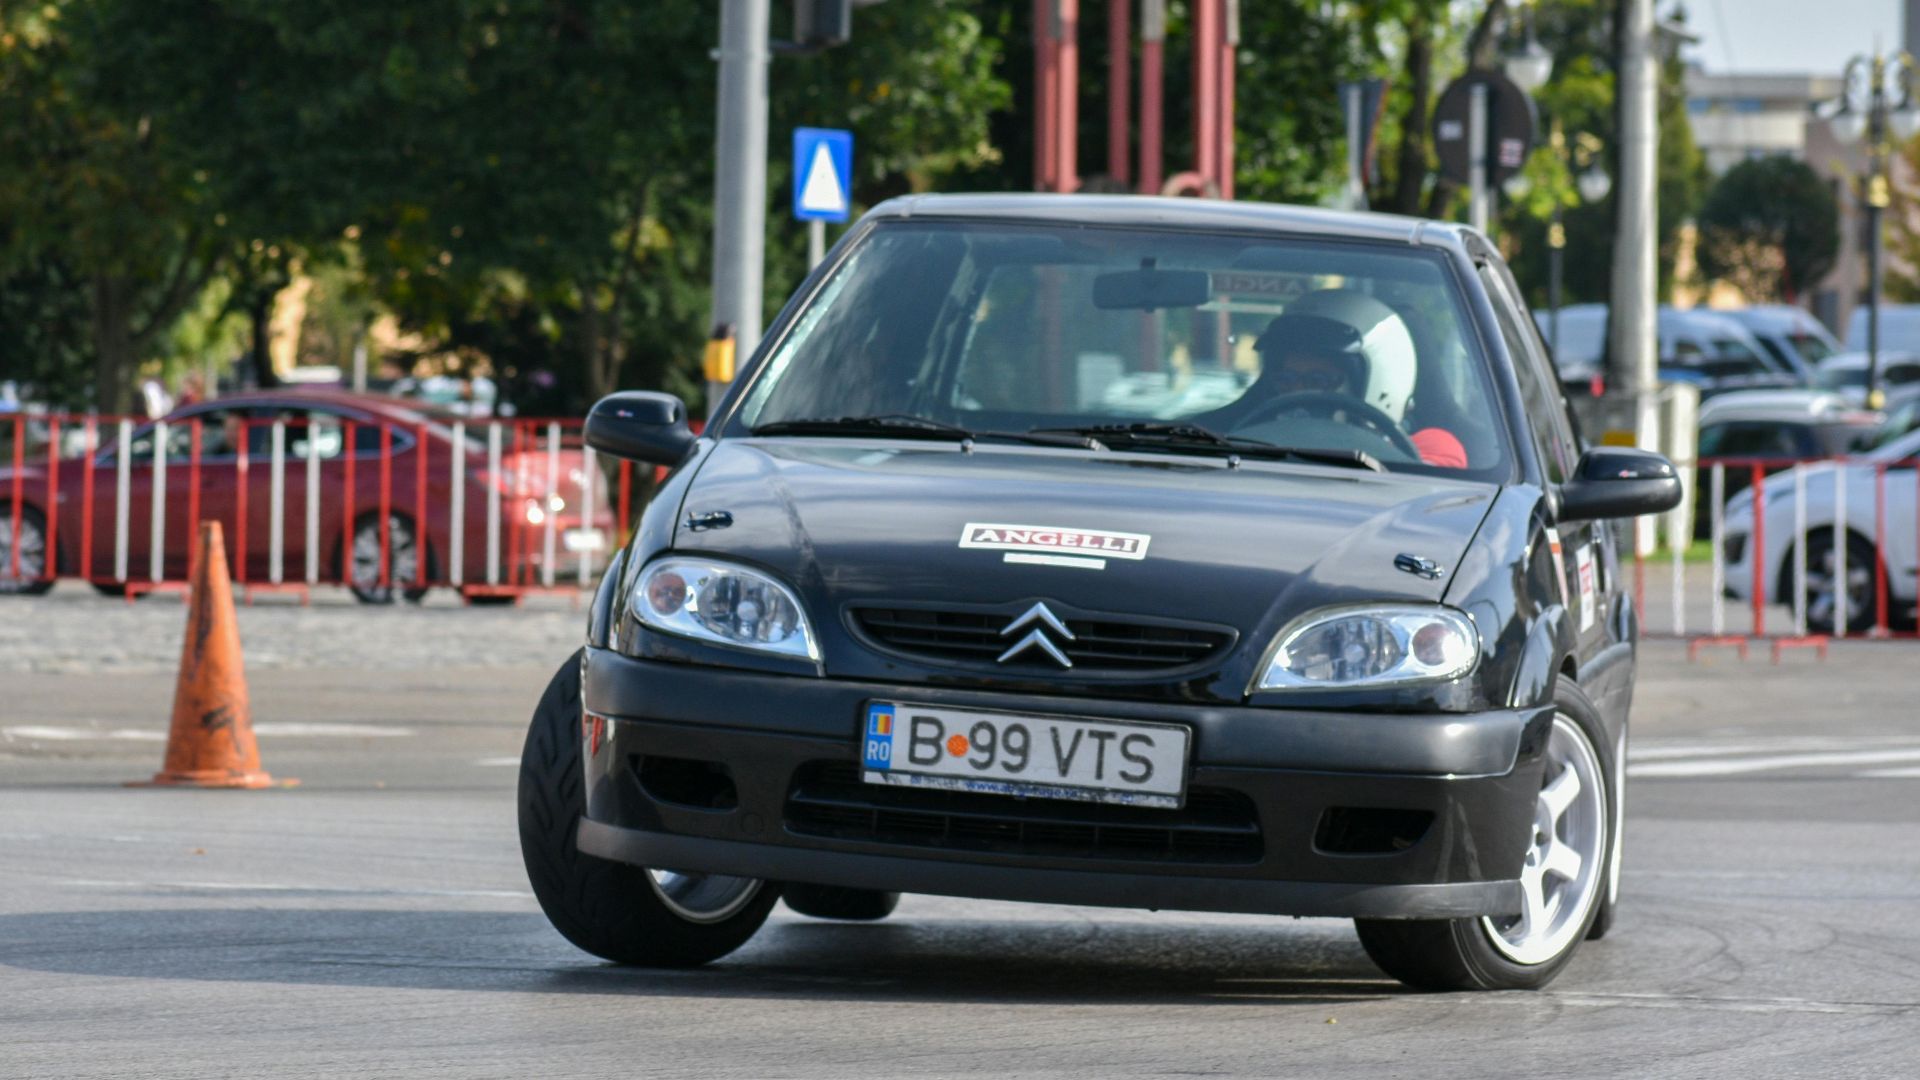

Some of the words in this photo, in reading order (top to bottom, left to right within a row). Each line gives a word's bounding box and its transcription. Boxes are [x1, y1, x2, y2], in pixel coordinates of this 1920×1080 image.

[973, 529, 1138, 553] ANGELLI
[867, 740, 890, 761] RO
[908, 716, 946, 766] B
[967, 721, 1031, 773] 99
[1050, 726, 1155, 784] VTS
